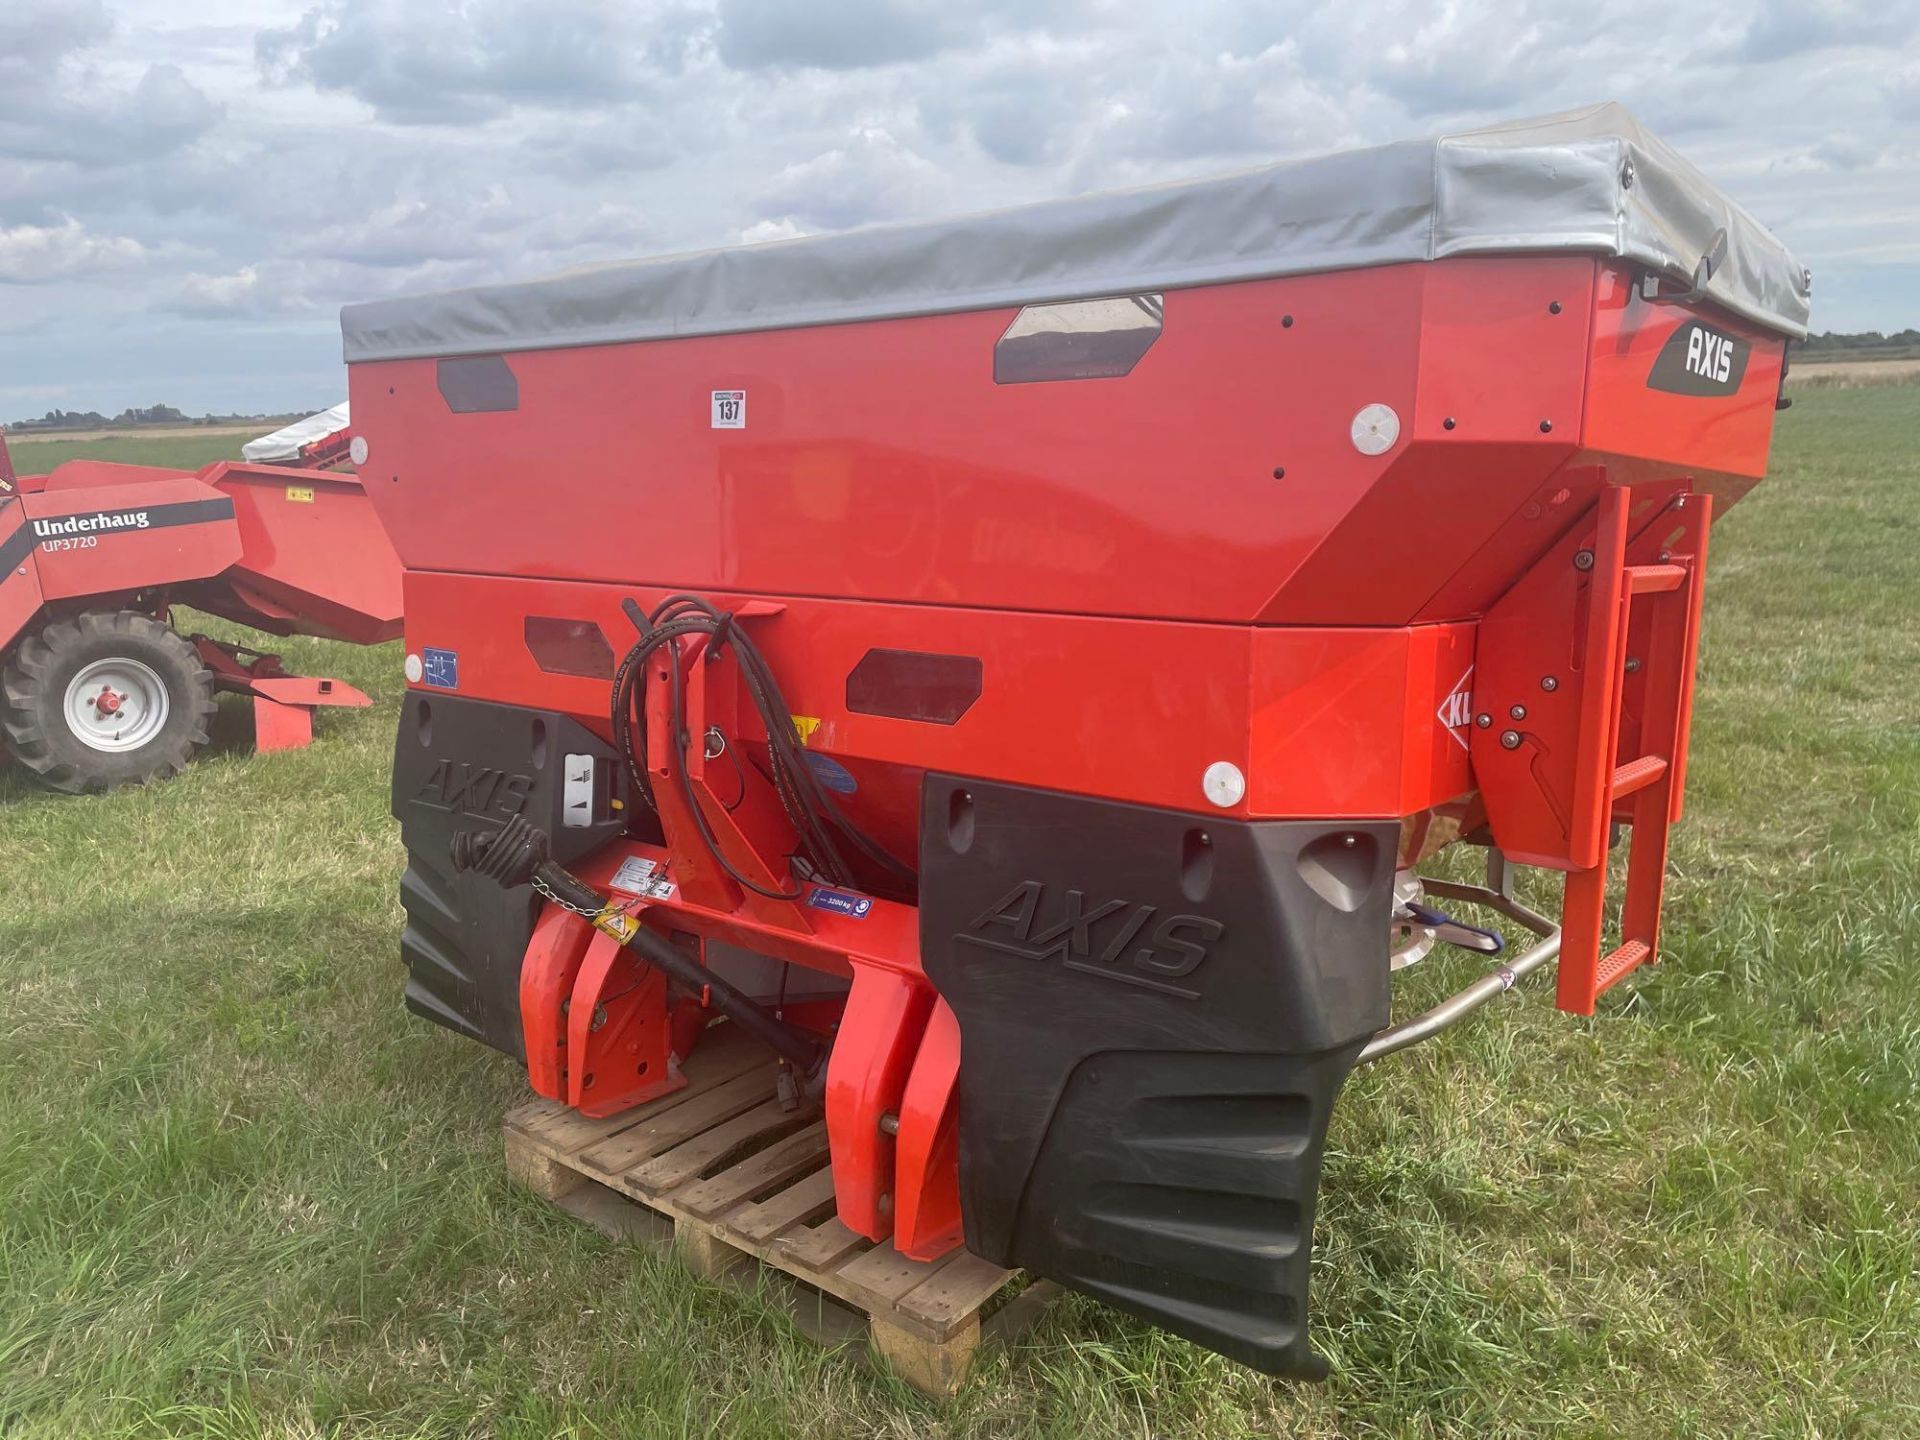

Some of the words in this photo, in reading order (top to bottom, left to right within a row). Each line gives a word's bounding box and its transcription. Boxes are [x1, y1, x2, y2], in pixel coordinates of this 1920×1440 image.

[1686, 326, 1734, 383] AXIS
[719, 401, 740, 420] 137
[34, 512, 150, 537] Underhaug
[42, 536, 97, 553] UP3720
[419, 759, 536, 815] AXIS
[968, 880, 1226, 977] AXIS
